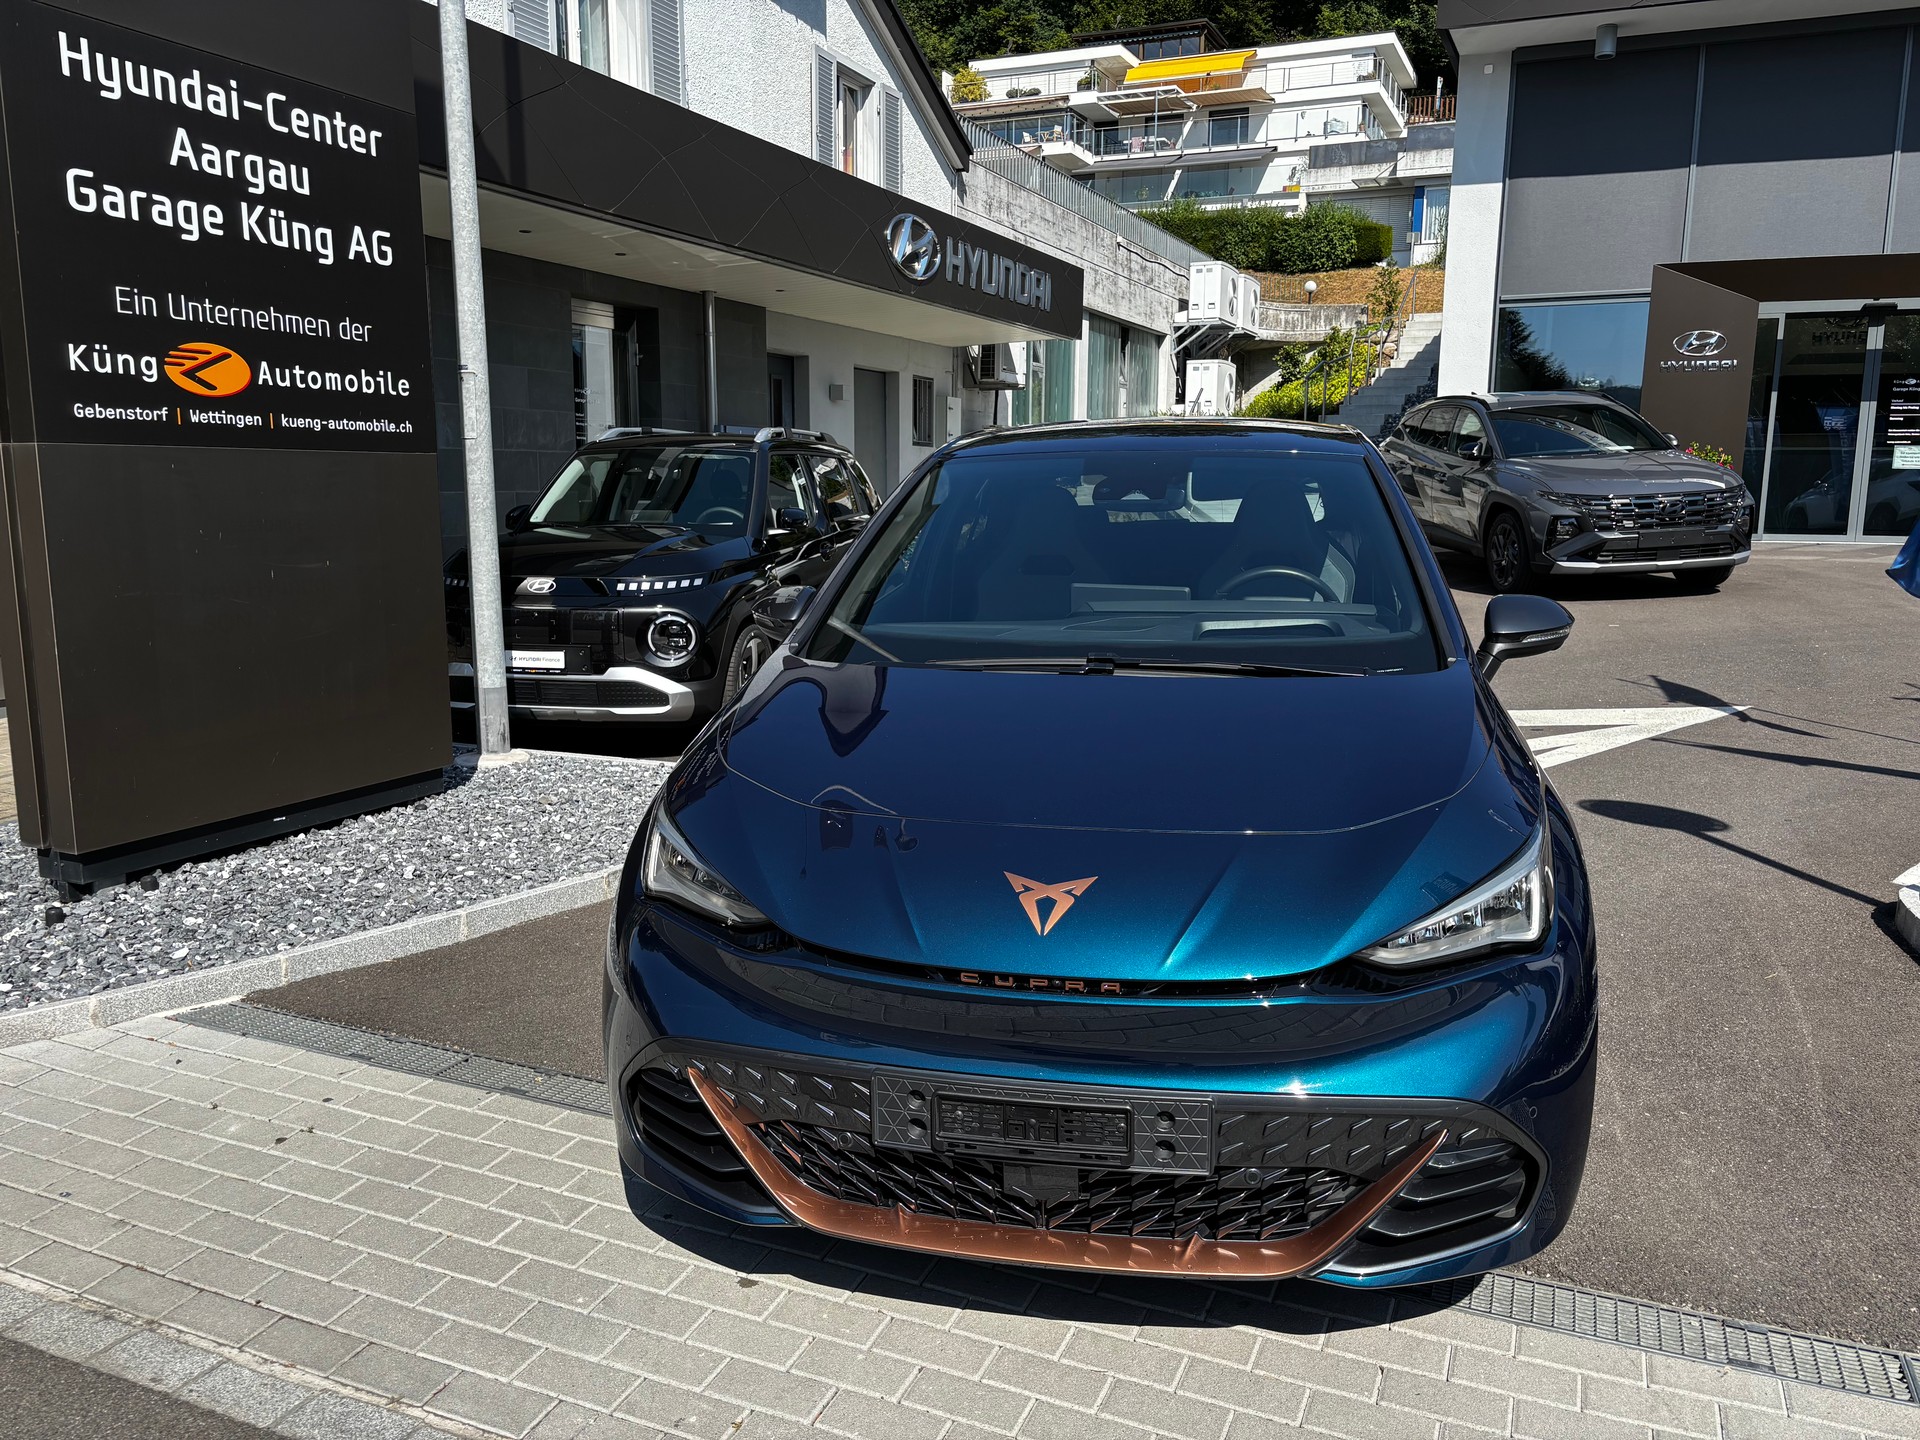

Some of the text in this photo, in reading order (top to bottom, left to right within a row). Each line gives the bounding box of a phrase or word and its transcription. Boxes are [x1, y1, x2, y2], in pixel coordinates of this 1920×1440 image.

[58, 31, 383, 157] Hyundai-Center
[169, 127, 310, 196] Aargau
[65, 168, 394, 267] Garage Küng AG
[945, 235, 1052, 312] HYUNDAI
[115, 286, 372, 342] Ein Unternehmen der
[68, 343, 410, 397] Küng Automobile
[1660, 359, 1738, 372] HYUNDAI
[73, 403, 413, 433] Gebenstorf Wettingen kueng-automobile.ch
[960, 972, 1121, 994] CUPRA
